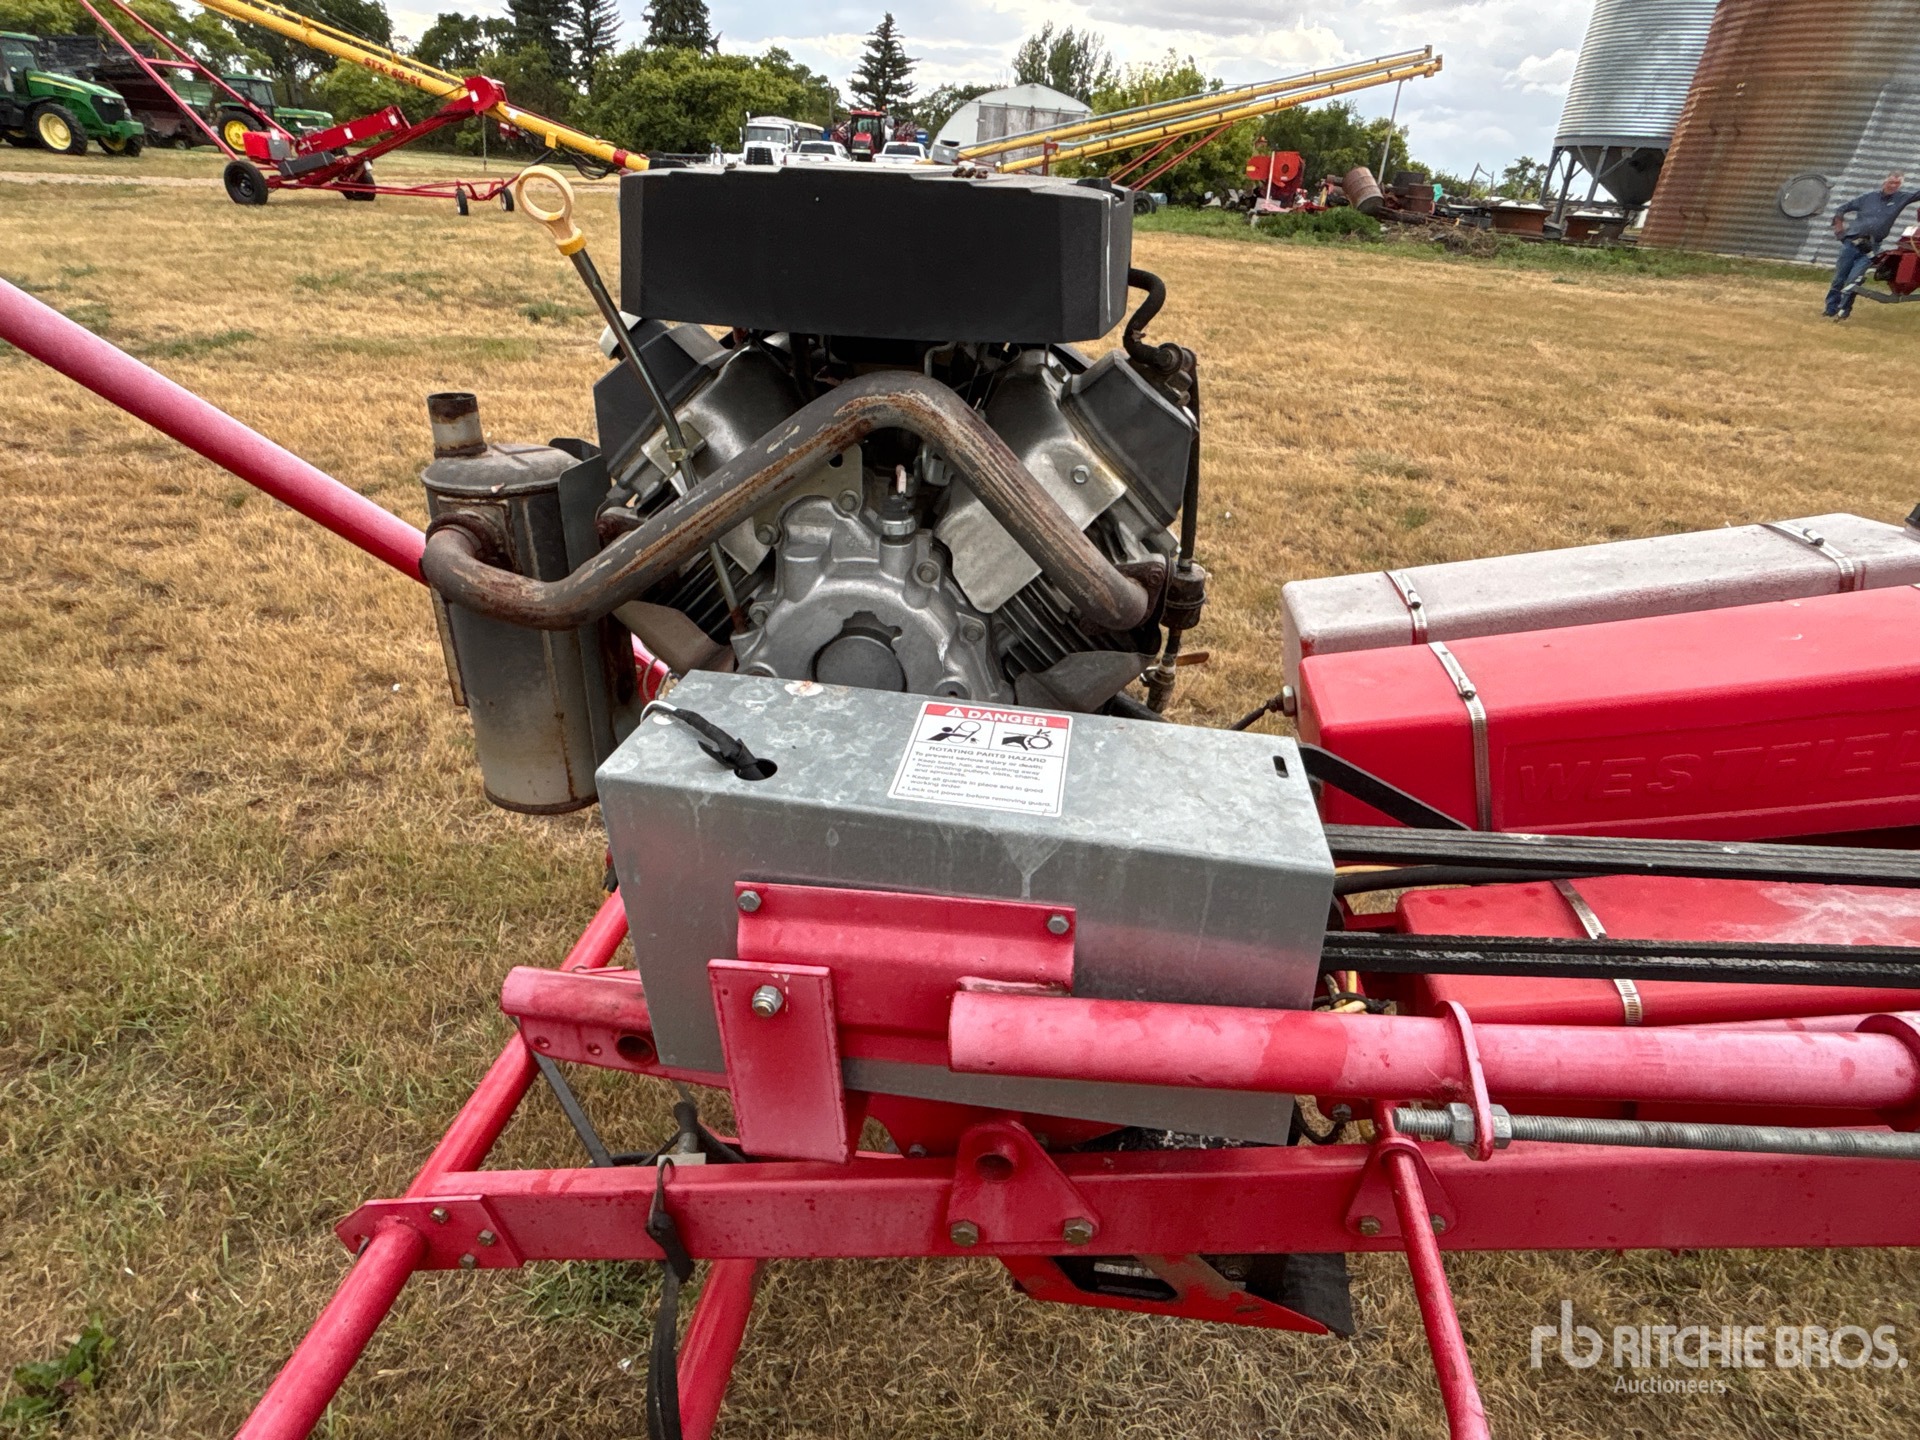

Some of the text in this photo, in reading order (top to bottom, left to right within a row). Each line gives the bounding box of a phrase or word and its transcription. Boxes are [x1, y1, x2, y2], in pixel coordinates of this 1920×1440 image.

[967, 710, 1048, 726] DANGER
[929, 746, 1047, 763] ROTATING PARTS HAZARD
[991, 766, 1019, 774] clothing
[992, 796, 1026, 804] removing
